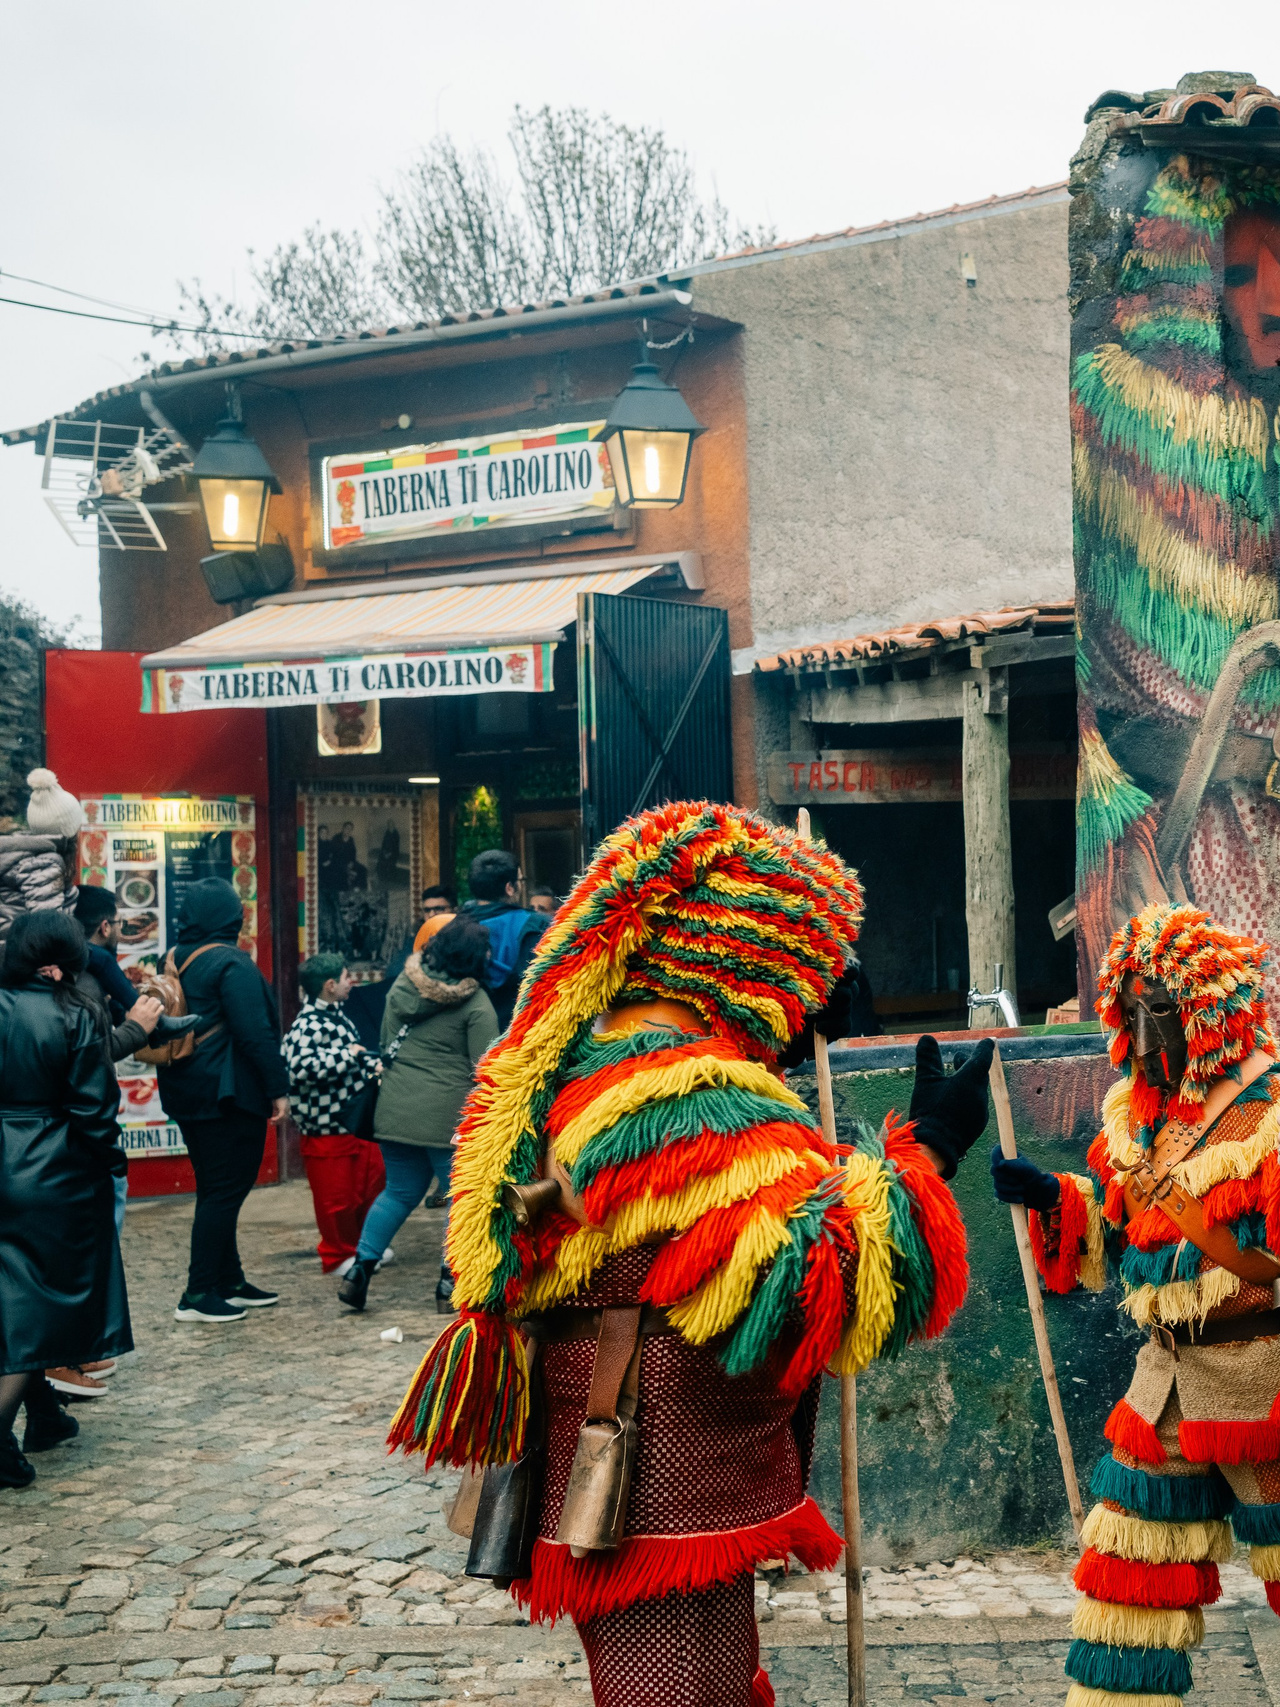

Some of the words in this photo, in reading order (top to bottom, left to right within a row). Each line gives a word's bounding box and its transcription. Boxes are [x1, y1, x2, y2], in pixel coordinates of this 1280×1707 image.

[360, 469, 451, 519] TABERNA
[487, 449, 592, 502] CAROLINO
[200, 669, 319, 700] TABERNA
[361, 656, 503, 691] CAROLINO
[788, 761, 875, 792] TASCA
[101, 803, 157, 822] TABERNA
[178, 803, 237, 822] CAROLINO
[121, 1129, 161, 1149] BERNA
